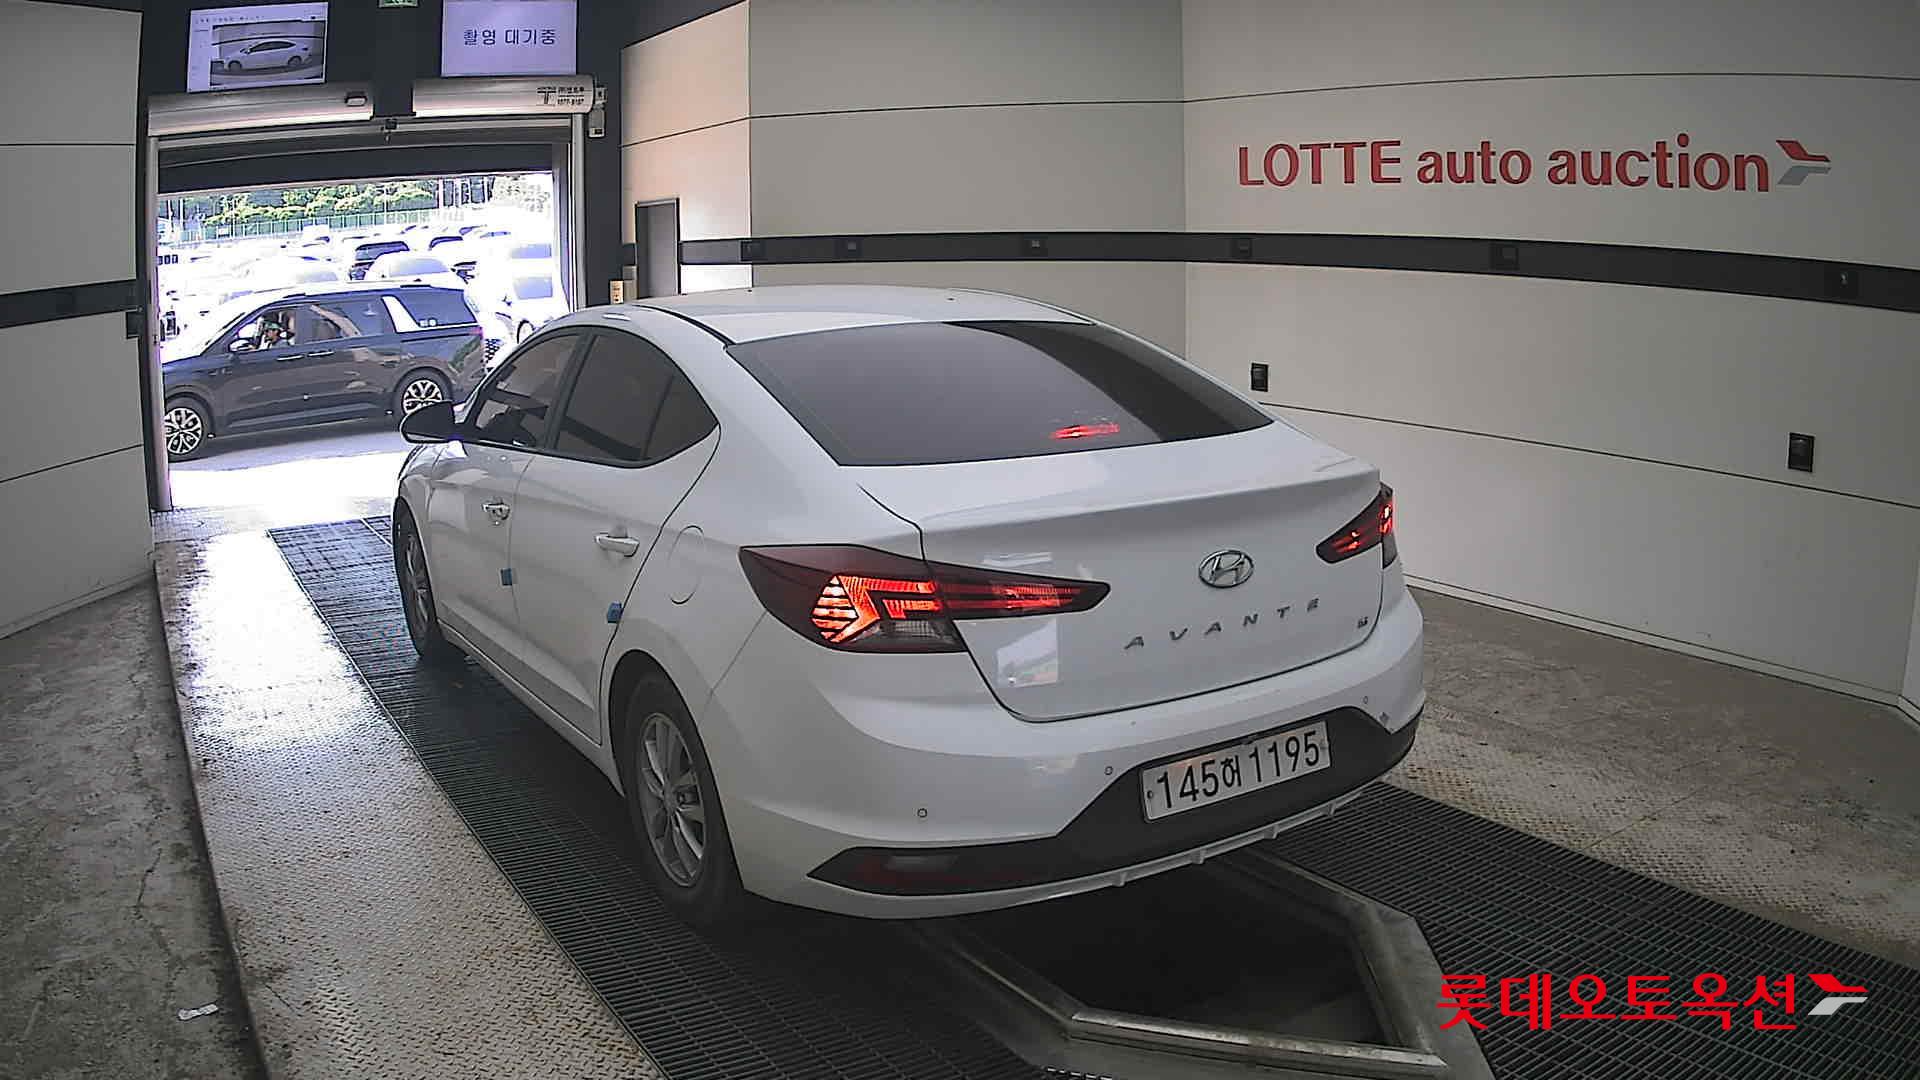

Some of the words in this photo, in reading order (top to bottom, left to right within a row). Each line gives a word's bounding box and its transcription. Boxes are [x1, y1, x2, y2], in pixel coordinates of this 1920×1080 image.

[464, 29, 497, 46] 촬영
[1239, 140, 1402, 187] LOTTE
[1417, 140, 1533, 186] auto
[1548, 133, 1770, 192] auction
[1123, 597, 1320, 650] AVANTE
